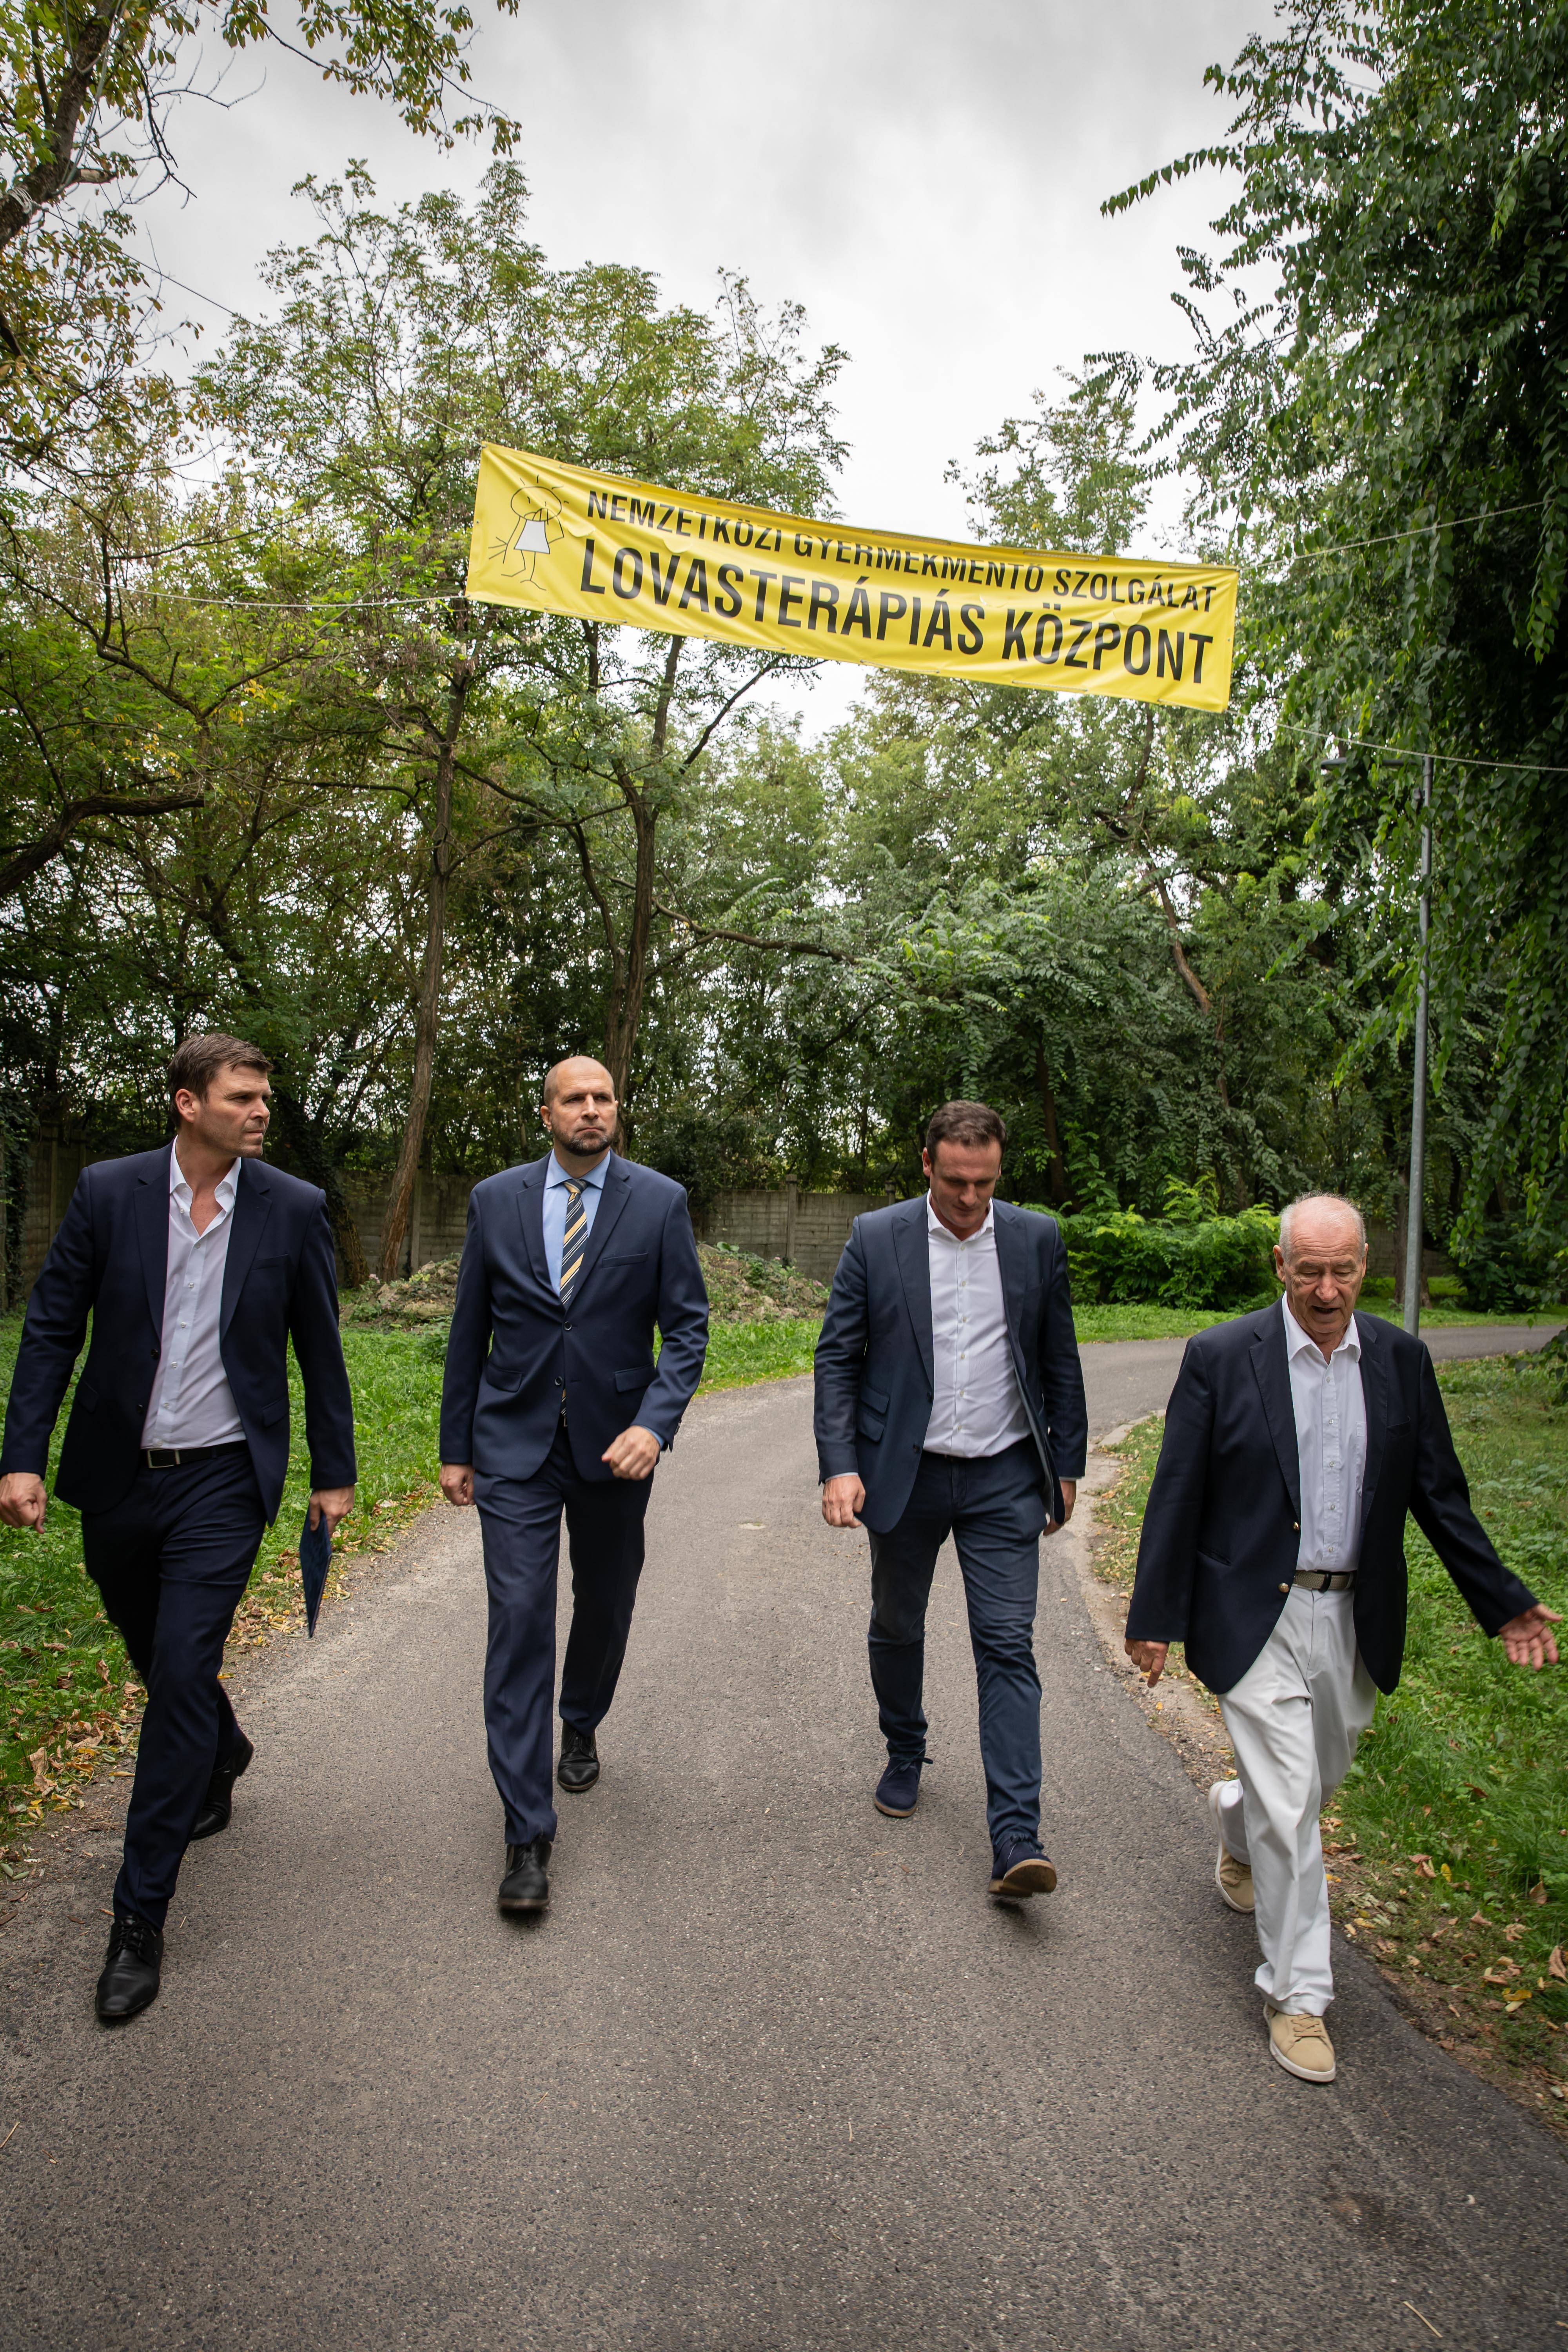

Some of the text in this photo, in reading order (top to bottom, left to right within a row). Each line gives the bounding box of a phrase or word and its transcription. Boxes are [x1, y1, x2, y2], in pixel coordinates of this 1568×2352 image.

[581, 538, 1213, 684] LOVASTERÁPIÁS KÖZPONT
[588, 490, 782, 552] NEMZETKÖZI
[1053, 568, 1217, 612] SZOLGÁLAT
